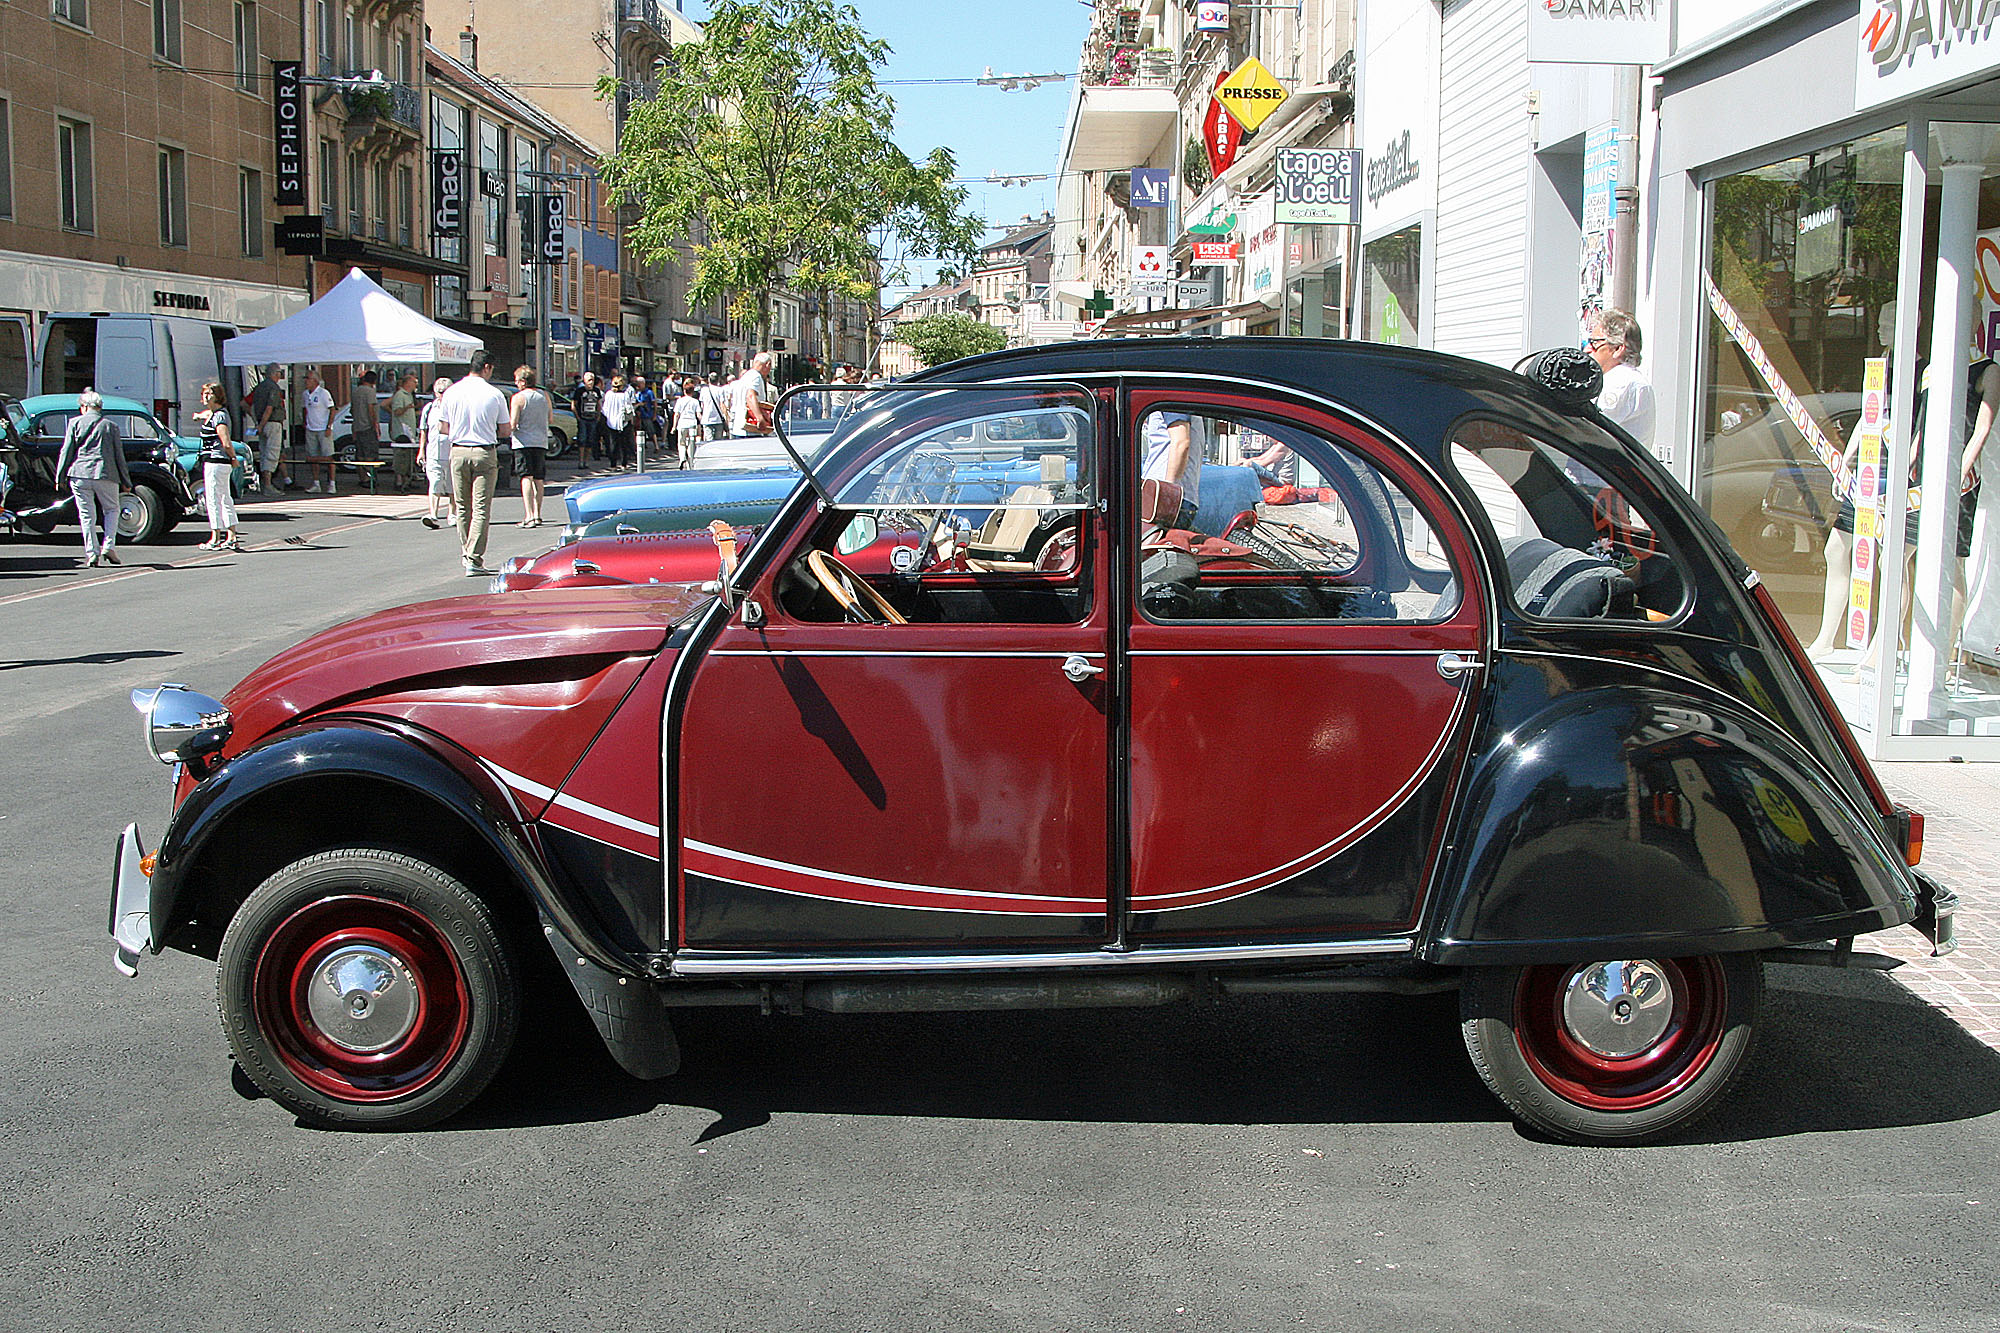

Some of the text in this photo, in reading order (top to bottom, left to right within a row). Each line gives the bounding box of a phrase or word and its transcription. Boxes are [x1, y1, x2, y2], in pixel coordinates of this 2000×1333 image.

[1223, 88, 1282, 99] PRESSE
[279, 66, 299, 191] SEPHORA
[1278, 149, 1338, 180] tape
[436, 155, 459, 229] fnac
[487, 172, 505, 197] fnac
[544, 198, 563, 258] fnac
[1198, 244, 1232, 254] L'EST
[153, 290, 210, 311] SEPHORA
